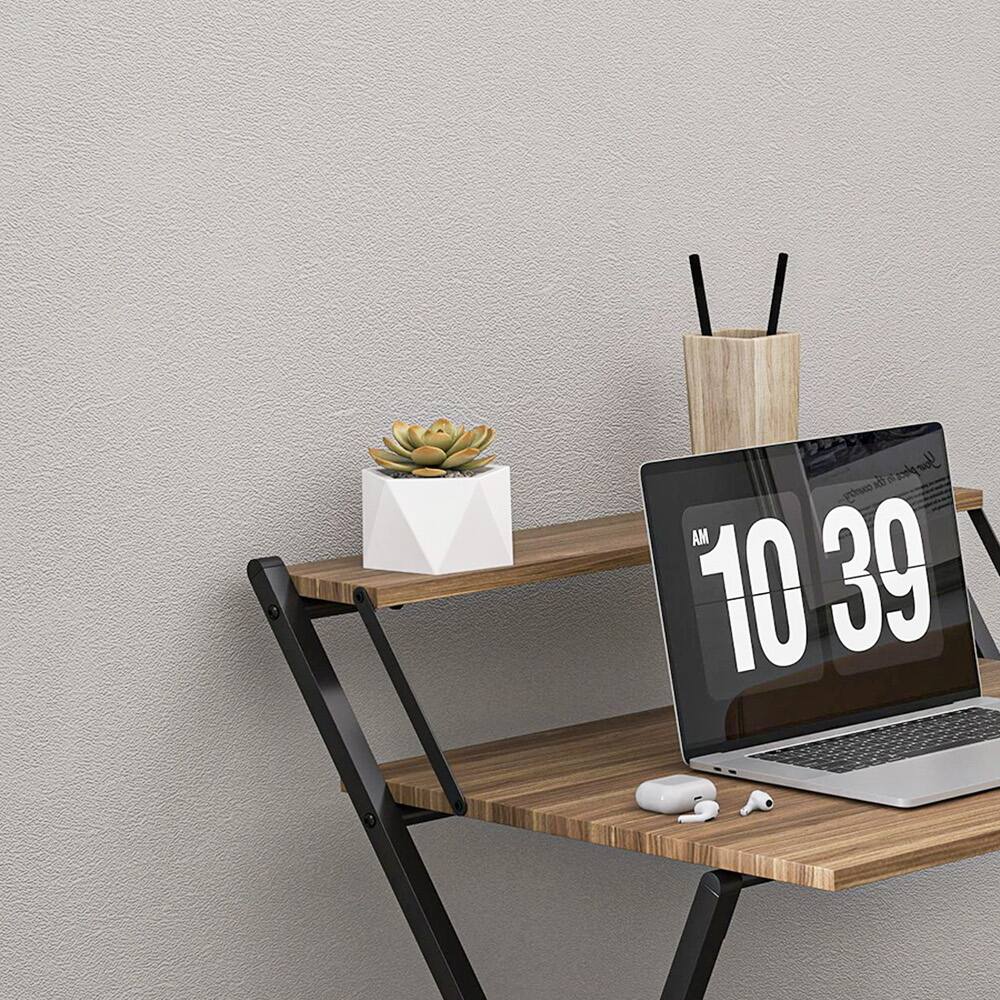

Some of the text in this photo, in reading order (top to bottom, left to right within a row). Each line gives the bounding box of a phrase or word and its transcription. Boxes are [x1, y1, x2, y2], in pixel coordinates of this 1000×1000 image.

[692, 528, 710, 547] AM
[699, 497, 931, 673] 10 39
